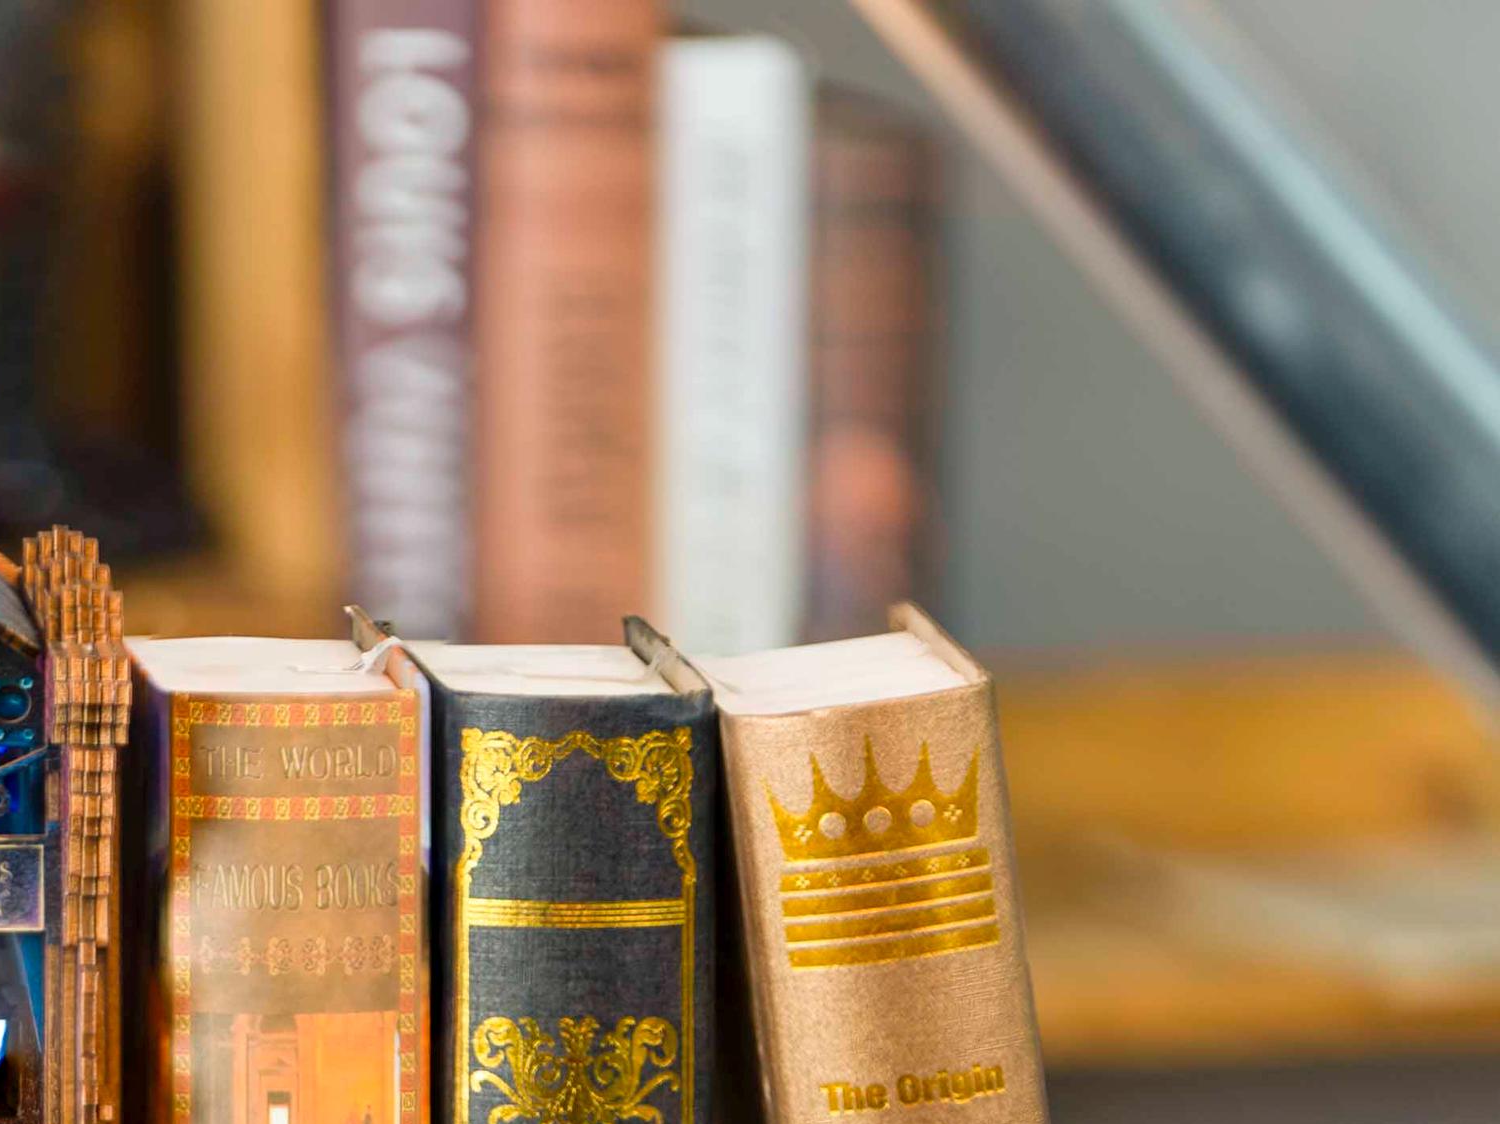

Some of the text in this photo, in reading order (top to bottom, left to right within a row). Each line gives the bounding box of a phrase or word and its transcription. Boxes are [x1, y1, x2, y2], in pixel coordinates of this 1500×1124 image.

[198, 745, 398, 780] THE WORLD
[194, 861, 401, 911] FAMOUS BOOKS
[819, 1063, 1007, 1116] The Origin
